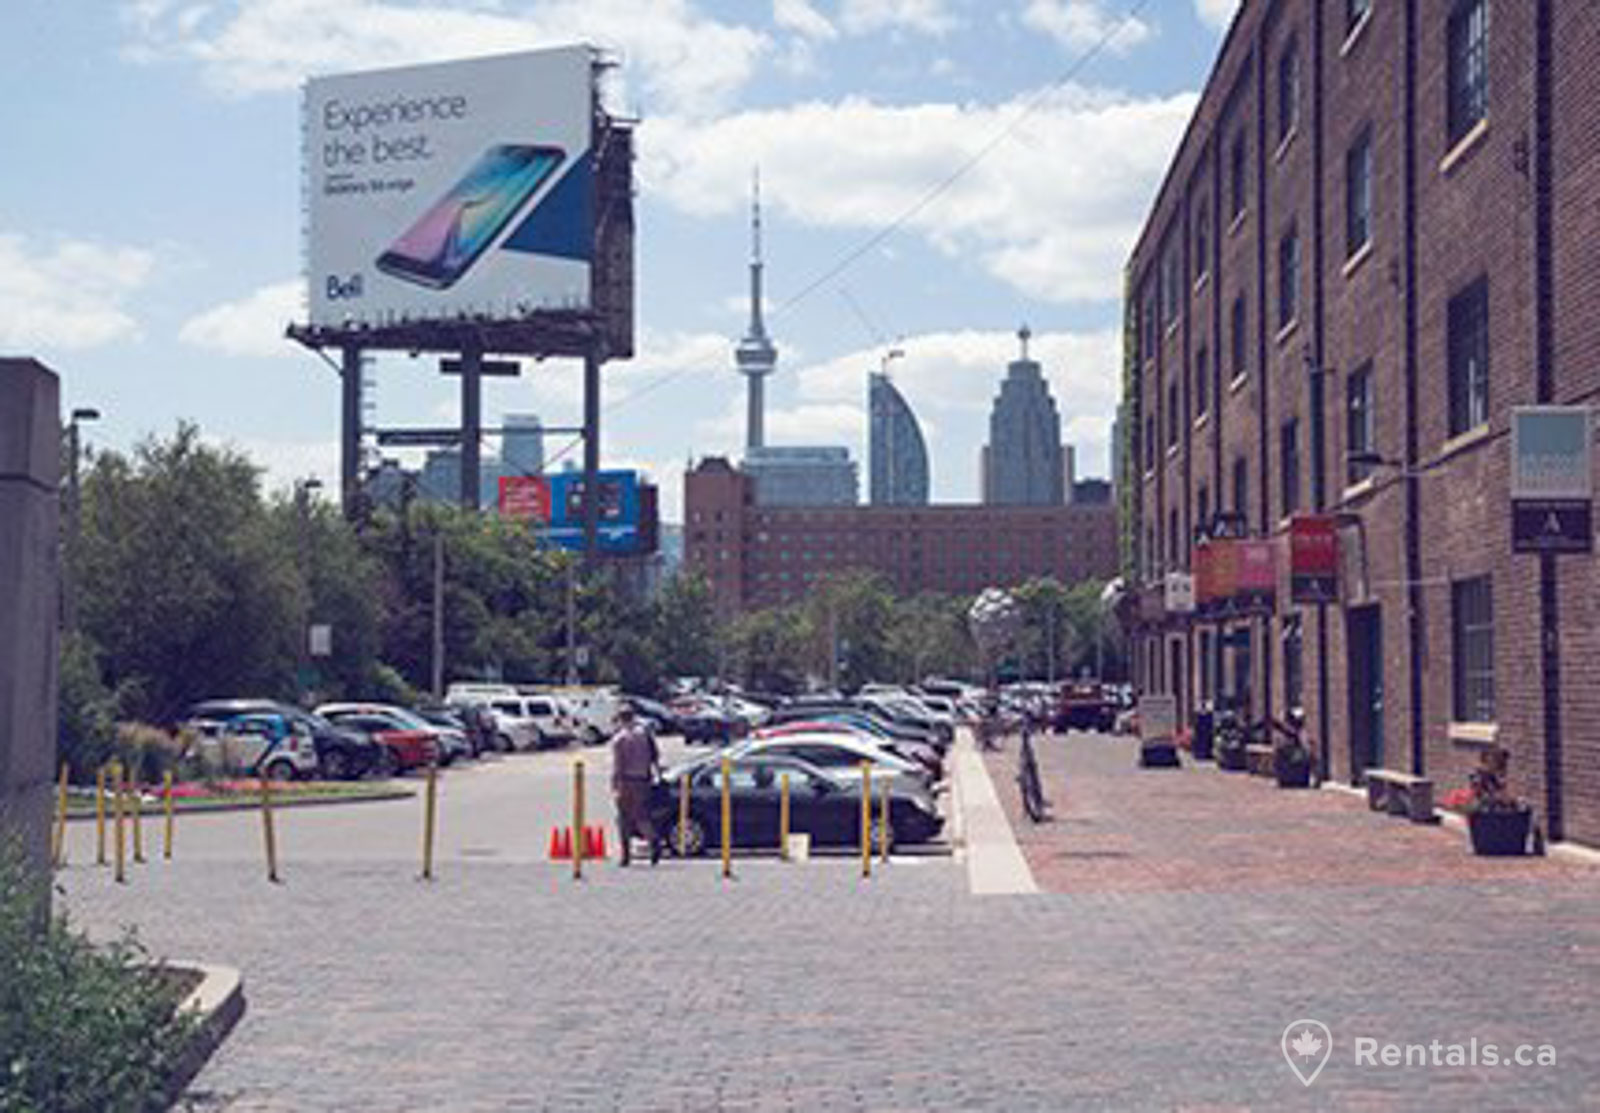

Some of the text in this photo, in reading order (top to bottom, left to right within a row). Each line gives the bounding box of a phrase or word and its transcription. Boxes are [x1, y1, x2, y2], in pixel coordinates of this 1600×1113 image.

[323, 92, 467, 134] Experience
[323, 136, 365, 168] the
[327, 273, 364, 301] Bell
